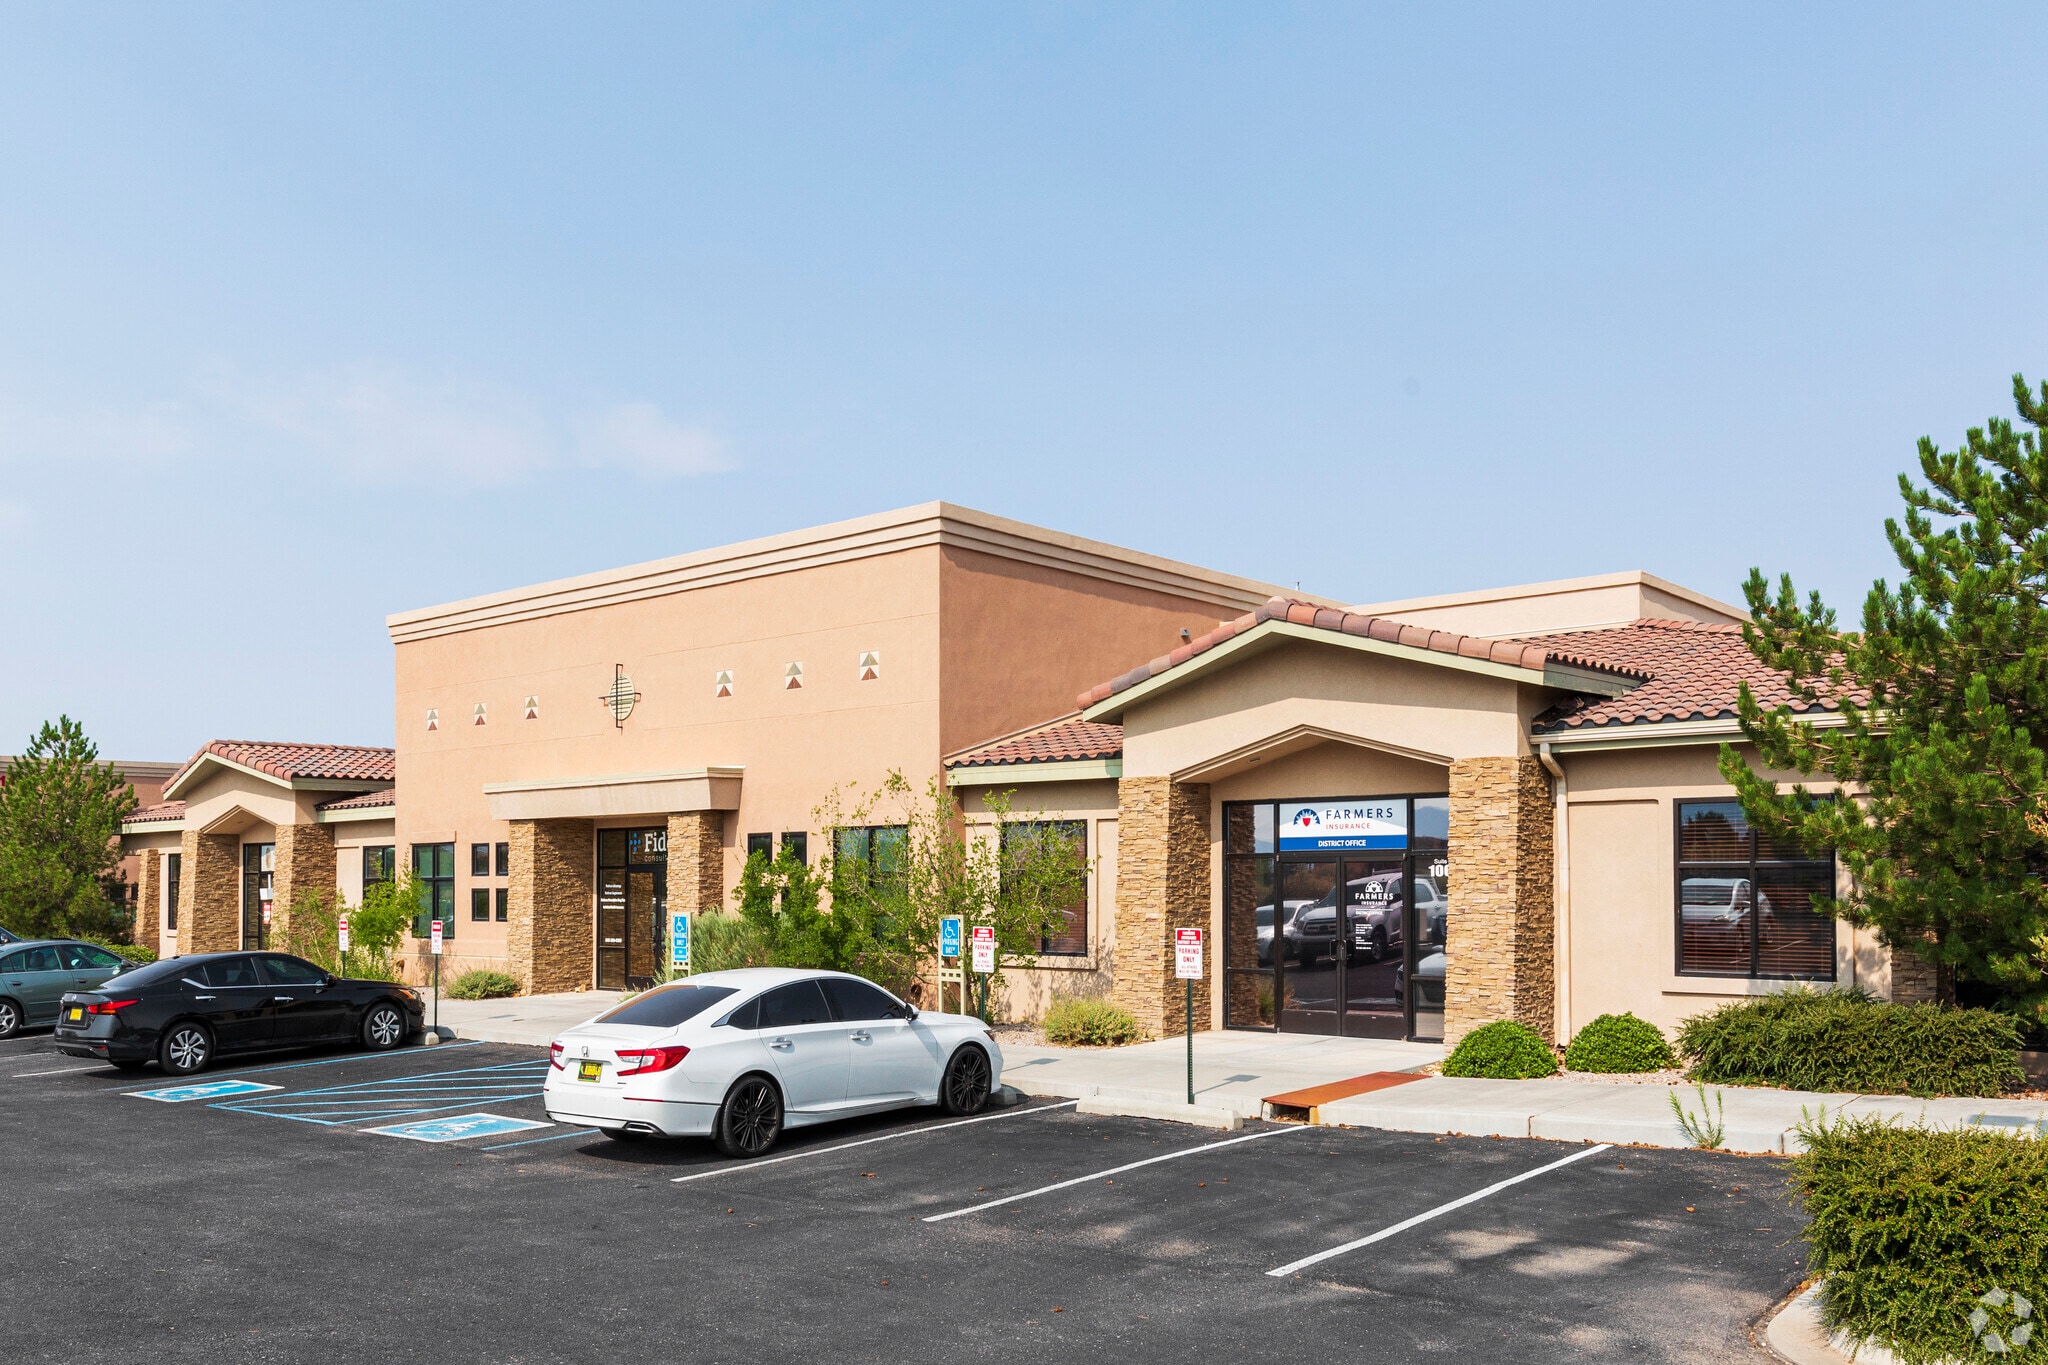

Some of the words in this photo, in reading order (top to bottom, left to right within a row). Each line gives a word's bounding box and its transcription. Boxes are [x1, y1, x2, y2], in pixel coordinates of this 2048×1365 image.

[1326, 808, 1393, 820] FARMERS
[1318, 840, 1344, 848] DISTRICT
[1345, 839, 1367, 847] OFFICE
